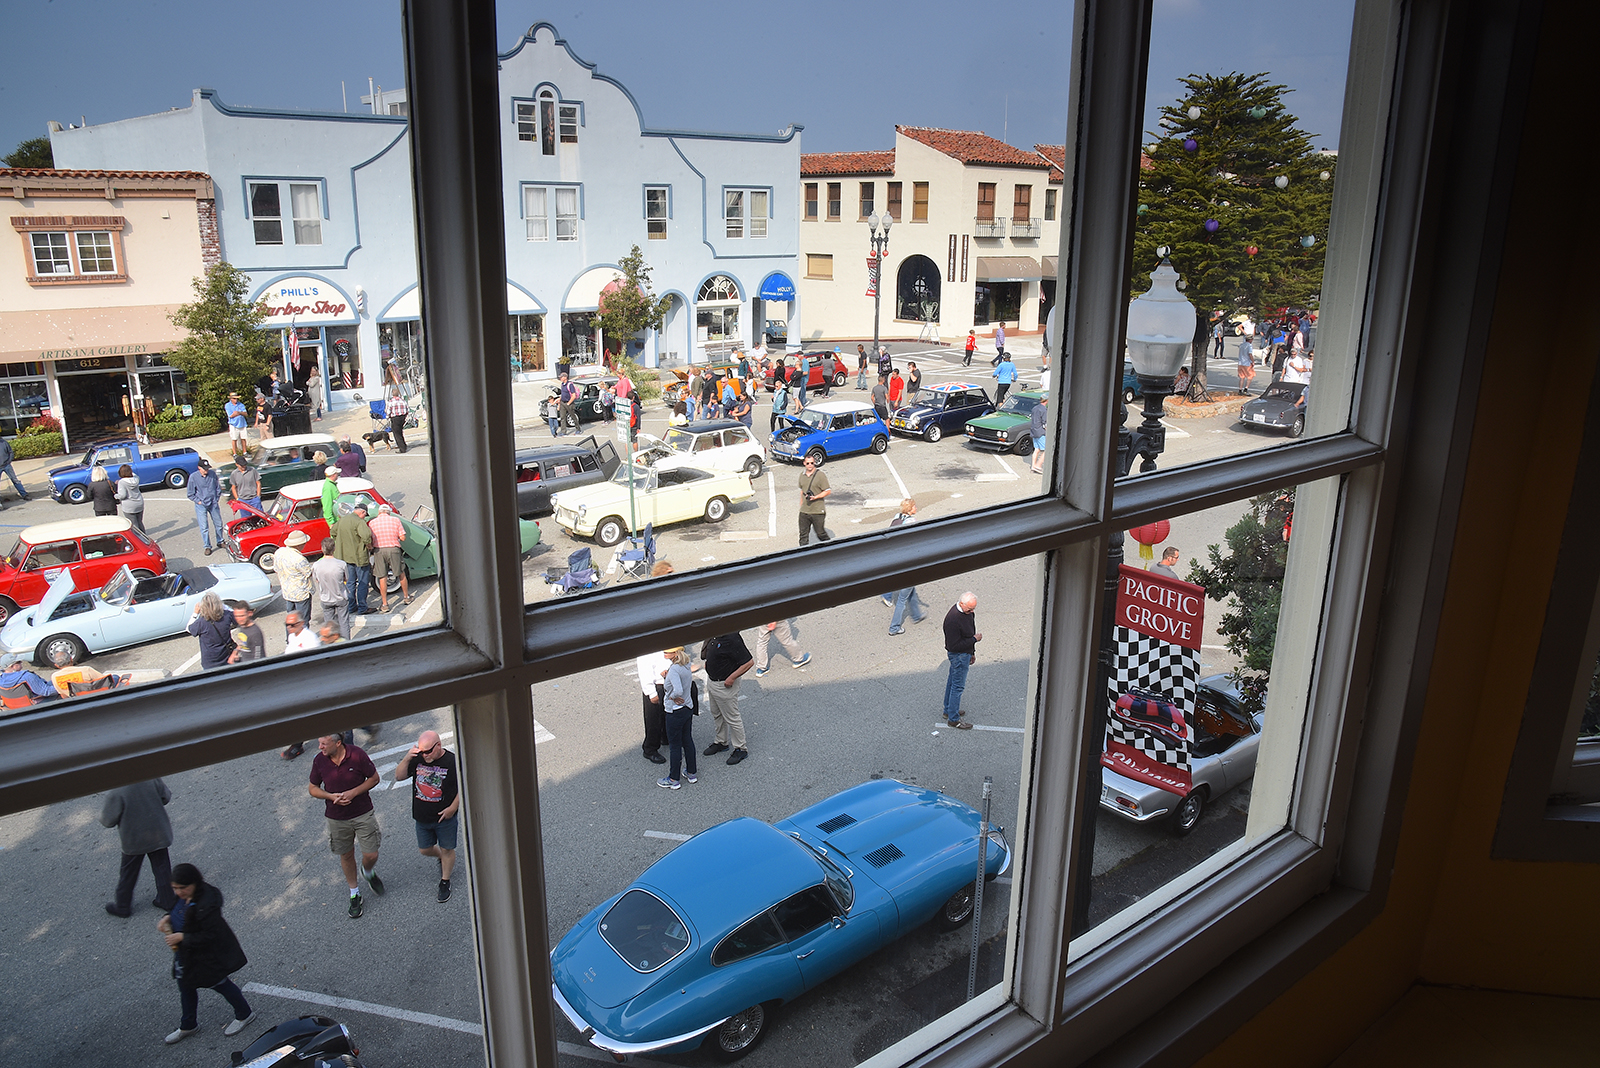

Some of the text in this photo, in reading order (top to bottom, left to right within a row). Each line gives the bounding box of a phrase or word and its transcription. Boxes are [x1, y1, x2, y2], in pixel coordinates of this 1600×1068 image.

[281, 287, 319, 296] PHILL'S
[311, 301, 346, 317] Shop
[38, 344, 148, 360] ARTISANA GALLERY
[80, 359, 100, 368] 612
[1124, 577, 1199, 616] PACIFIC
[1125, 604, 1192, 640] GROVE
